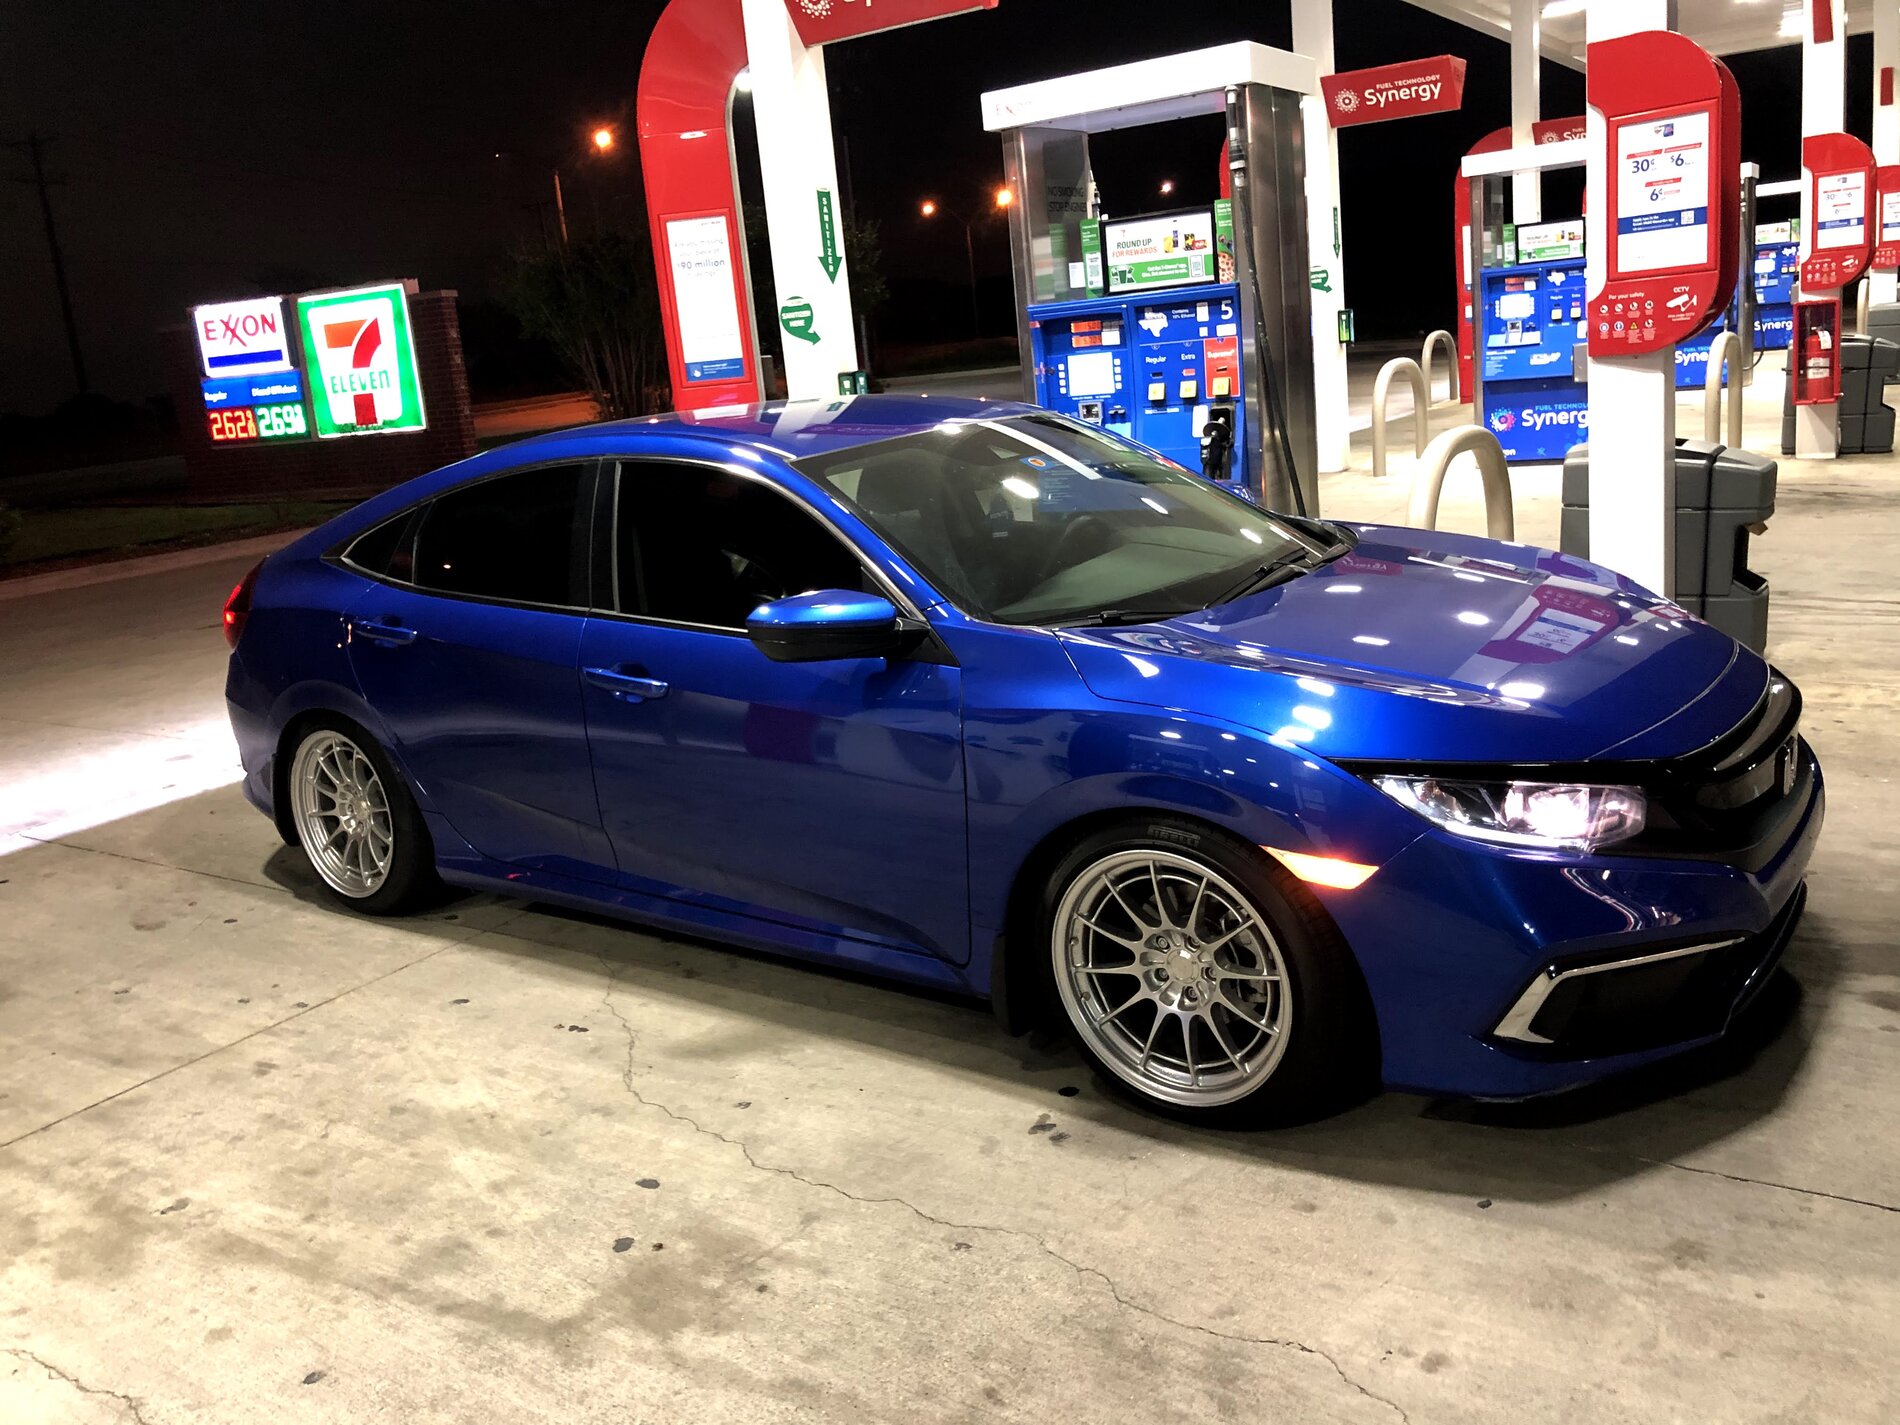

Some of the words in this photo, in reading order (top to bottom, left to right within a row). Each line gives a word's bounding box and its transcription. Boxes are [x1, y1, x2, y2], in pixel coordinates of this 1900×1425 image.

[1394, 74, 1440, 87] TECHNOLOGY
[1364, 82, 1442, 108] Synergy
[822, 197, 834, 273] SANITIZER
[1116, 239, 1142, 249] ROUND
[1142, 238, 1152, 247] UP
[1112, 250, 1124, 258] FOR
[1125, 246, 1158, 257] REWARDS
[695, 259, 725, 269] million
[1221, 300, 1233, 320] 5
[203, 312, 277, 348] EXXON
[1754, 320, 1793, 332] Synerg
[1145, 356, 1166, 364] Regular
[1675, 350, 1709, 367] Syne
[323, 317, 381, 426] 7
[1554, 402, 1588, 410] TECHNOL
[1521, 408, 1588, 431] Synerg
